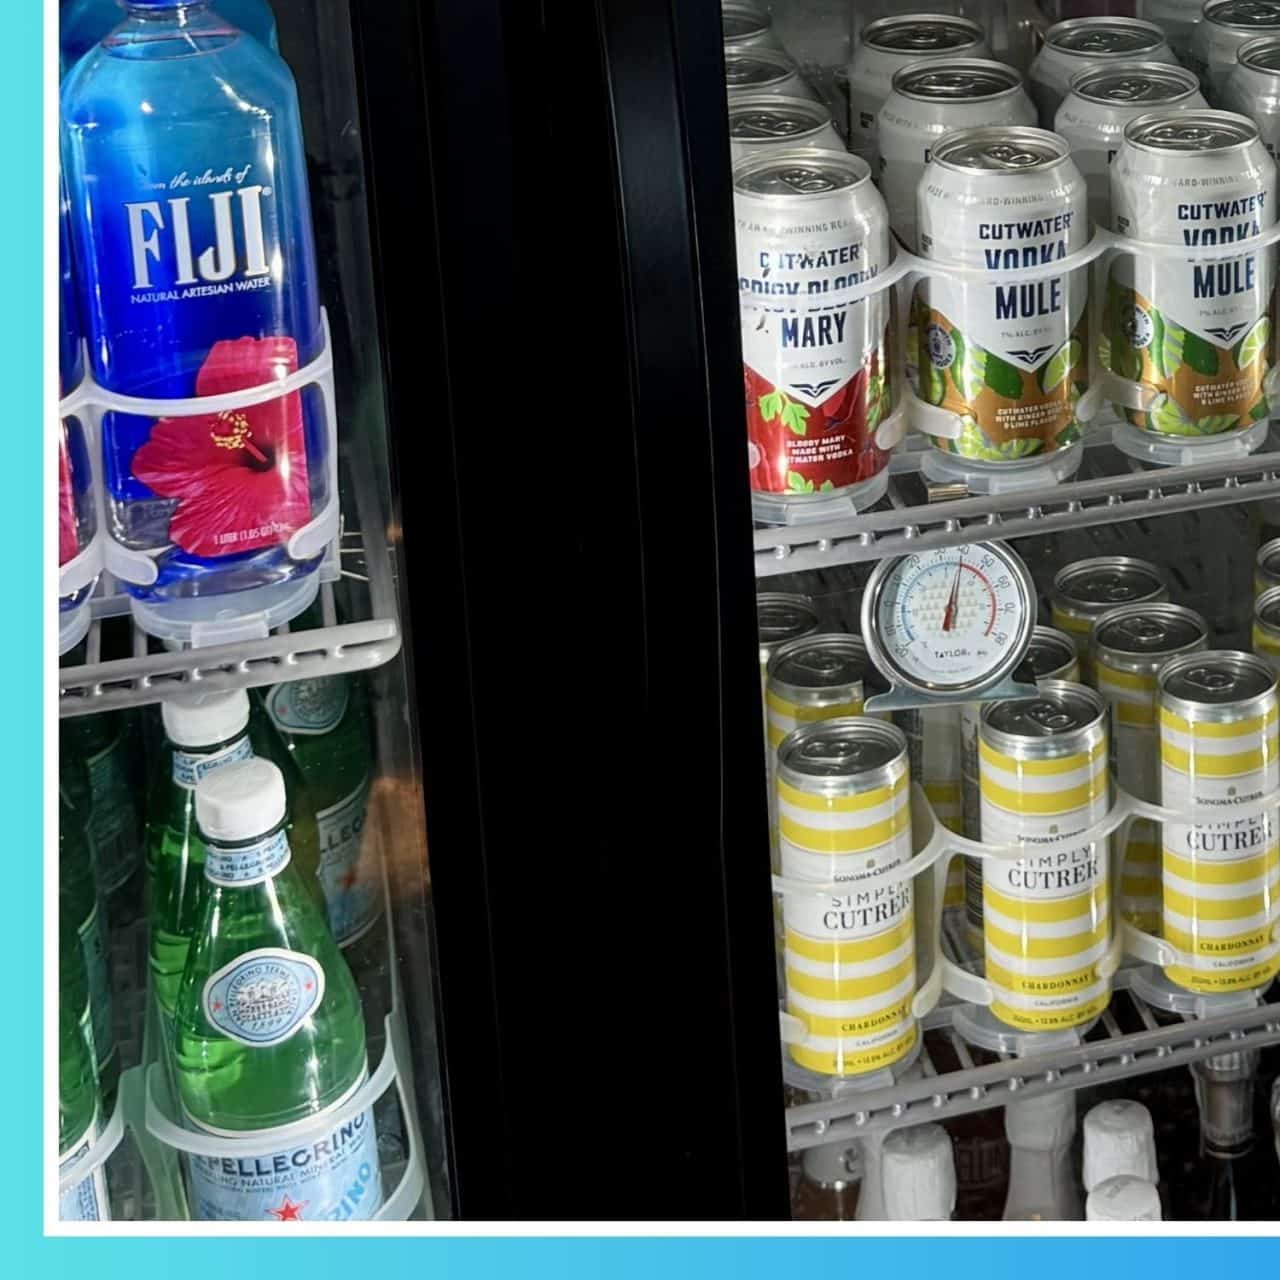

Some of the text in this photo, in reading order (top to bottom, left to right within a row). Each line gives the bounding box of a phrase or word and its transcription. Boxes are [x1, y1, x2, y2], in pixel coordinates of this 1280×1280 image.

[169, 164, 252, 190] the islands of
[1177, 195, 1266, 221] CUTWATER
[124, 185, 270, 289] FIJI
[978, 213, 1073, 241] CUTWATER
[131, 276, 271, 304] NATURAL ARTESIAN WATER
[1193, 258, 1255, 300] MULE
[995, 278, 1061, 320] MULE
[781, 310, 847, 349] MARY
[1186, 822, 1273, 852] CUTRER
[1008, 858, 1100, 891] CUTRER
[823, 887, 911, 931] CUTRER
